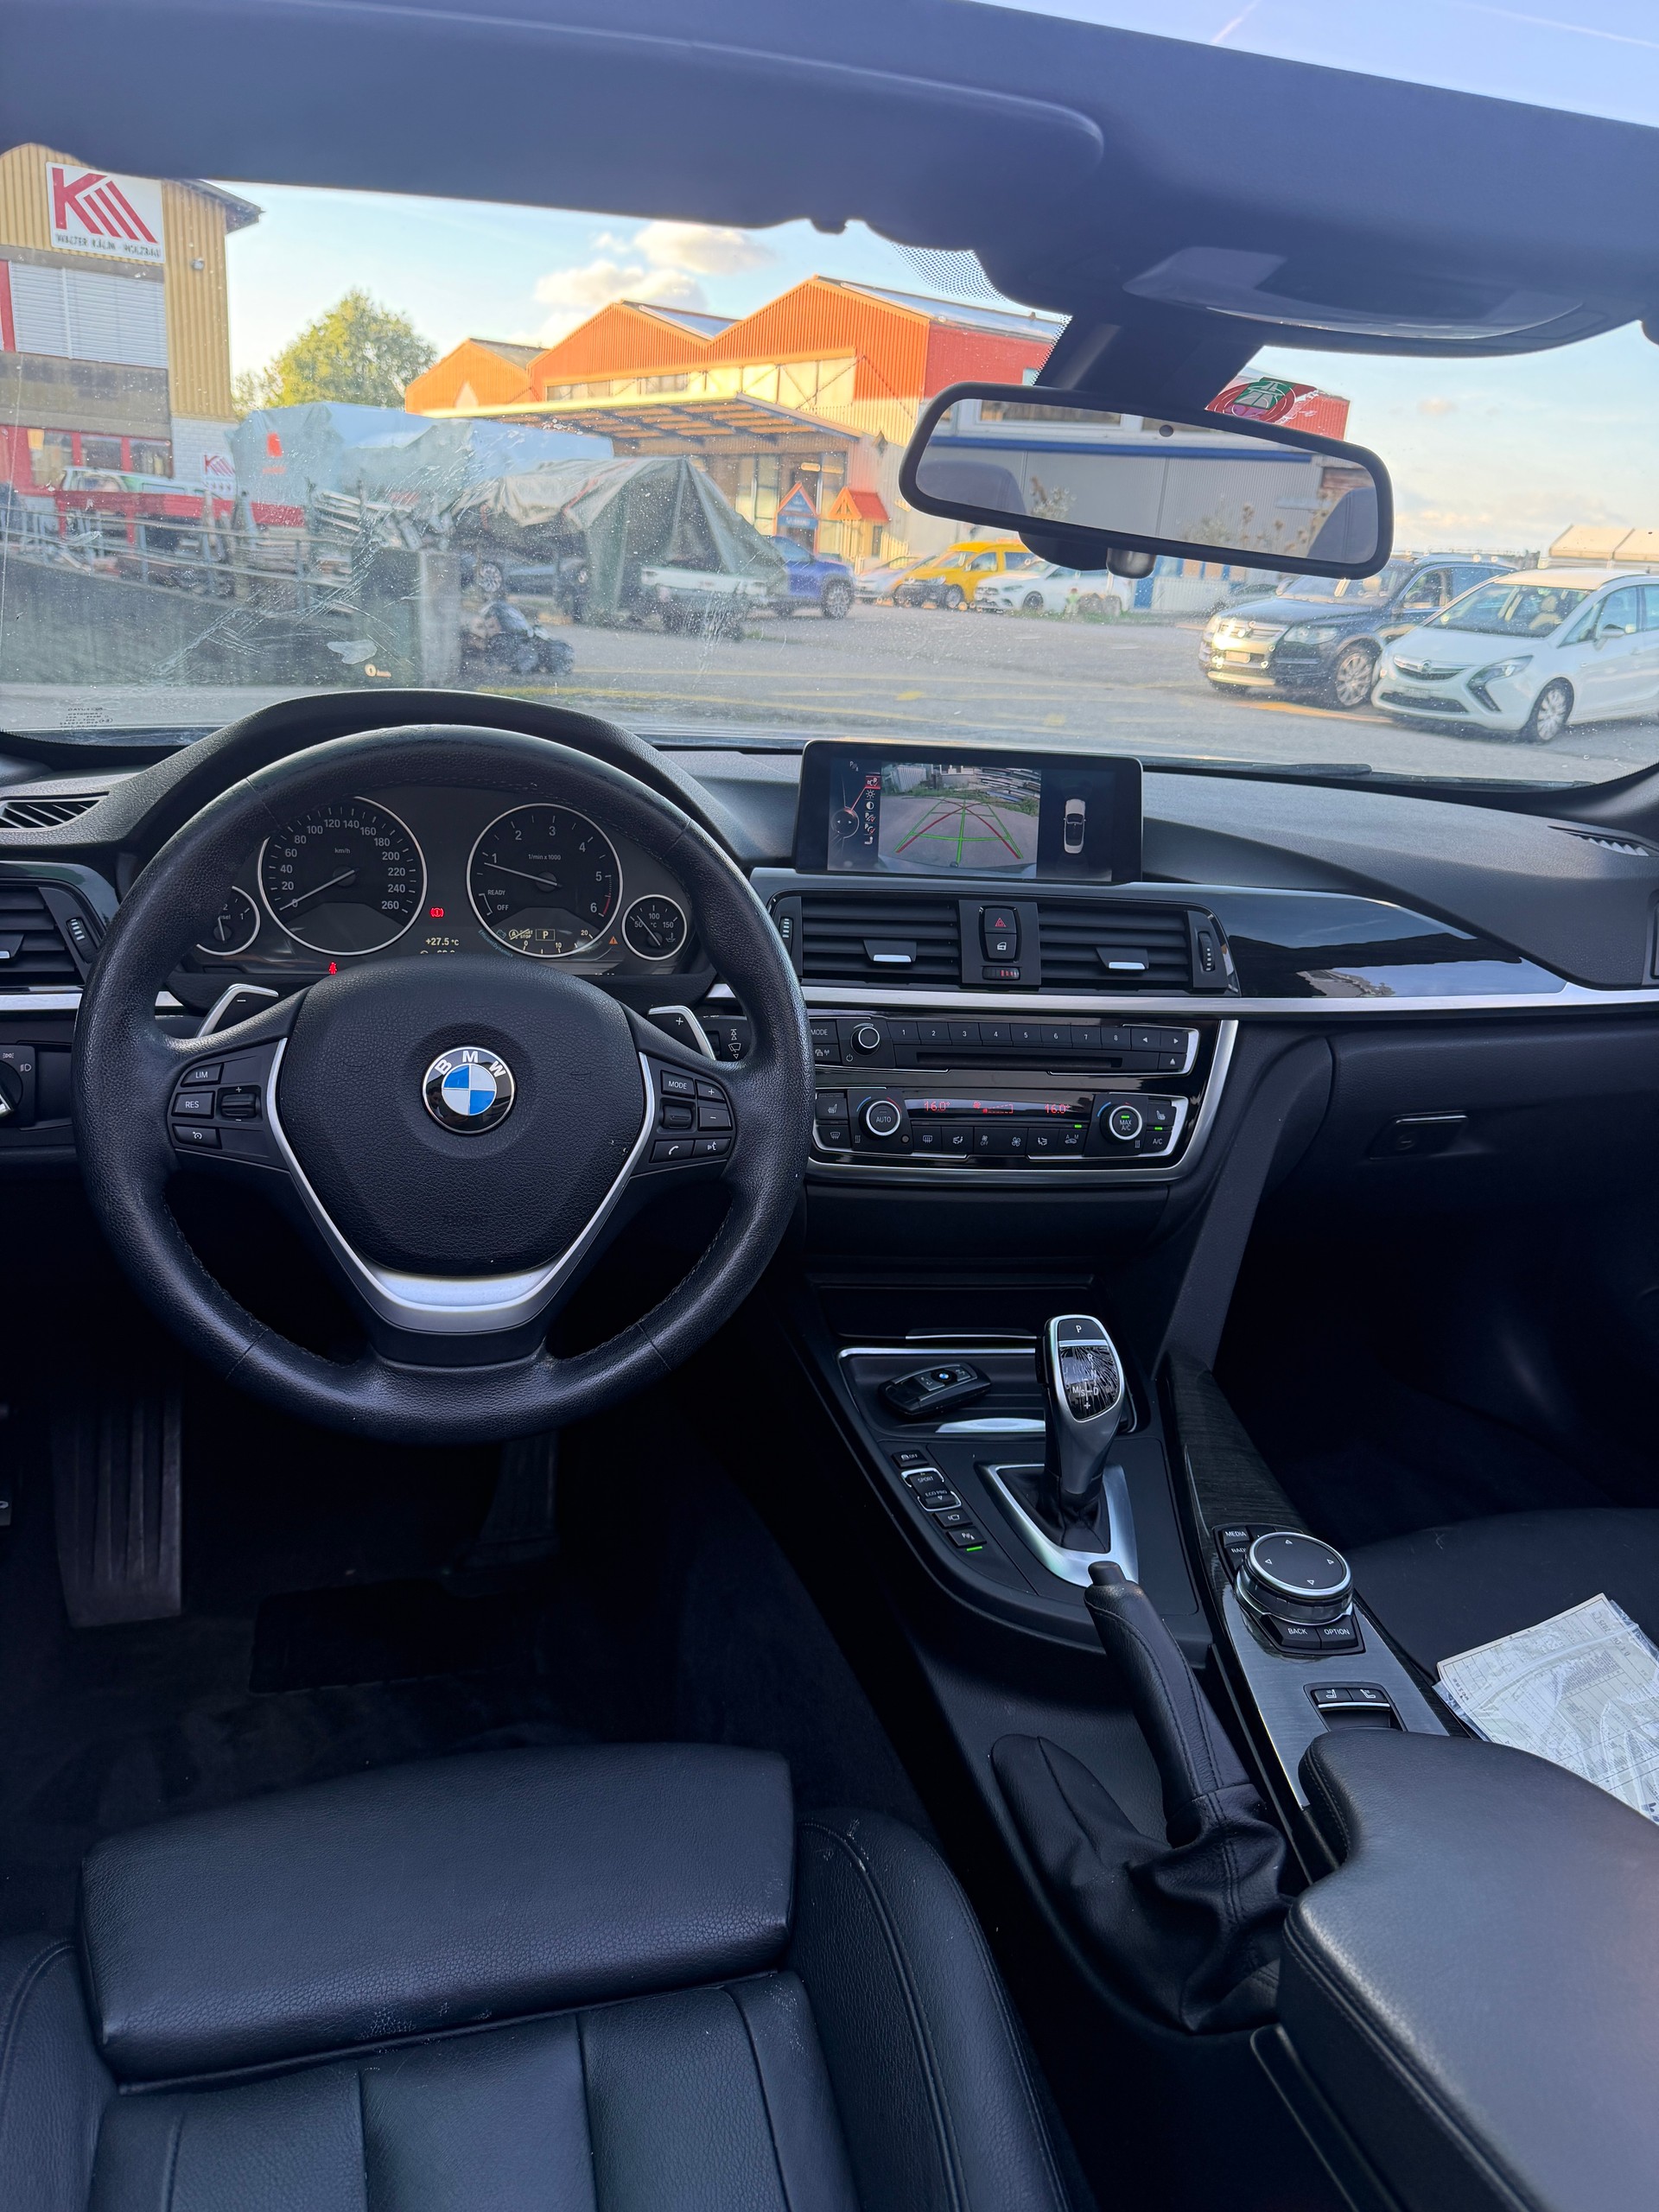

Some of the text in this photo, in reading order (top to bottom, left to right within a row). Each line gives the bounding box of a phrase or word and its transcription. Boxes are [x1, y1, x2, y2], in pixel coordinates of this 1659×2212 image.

[324, 819, 340, 828] 120
[343, 820, 359, 829] 140
[307, 825, 323, 835] 100
[360, 827, 377, 836] 160
[549, 826, 556, 836] 3
[294, 835, 307, 844] 80
[515, 830, 522, 841] 2
[374, 837, 391, 847] 180
[579, 842, 586, 852] 4
[284, 849, 298, 858] 60
[382, 851, 400, 861] 200
[492, 853, 497, 864] 1
[280, 864, 293, 874] 40
[387, 867, 406, 877] 220
[595, 871, 602, 881] 5
[282, 881, 295, 891] 20
[387, 883, 406, 893] 240
[381, 900, 399, 910] 260
[590, 902, 597, 913] 6
[425, 937, 449, 946] +27.5
[434, 1050, 506, 1078] BMW
[668, 1080, 687, 1090] MODE
[1076, 1325, 1082, 1333] P
[1093, 1387, 1099, 1395] D
